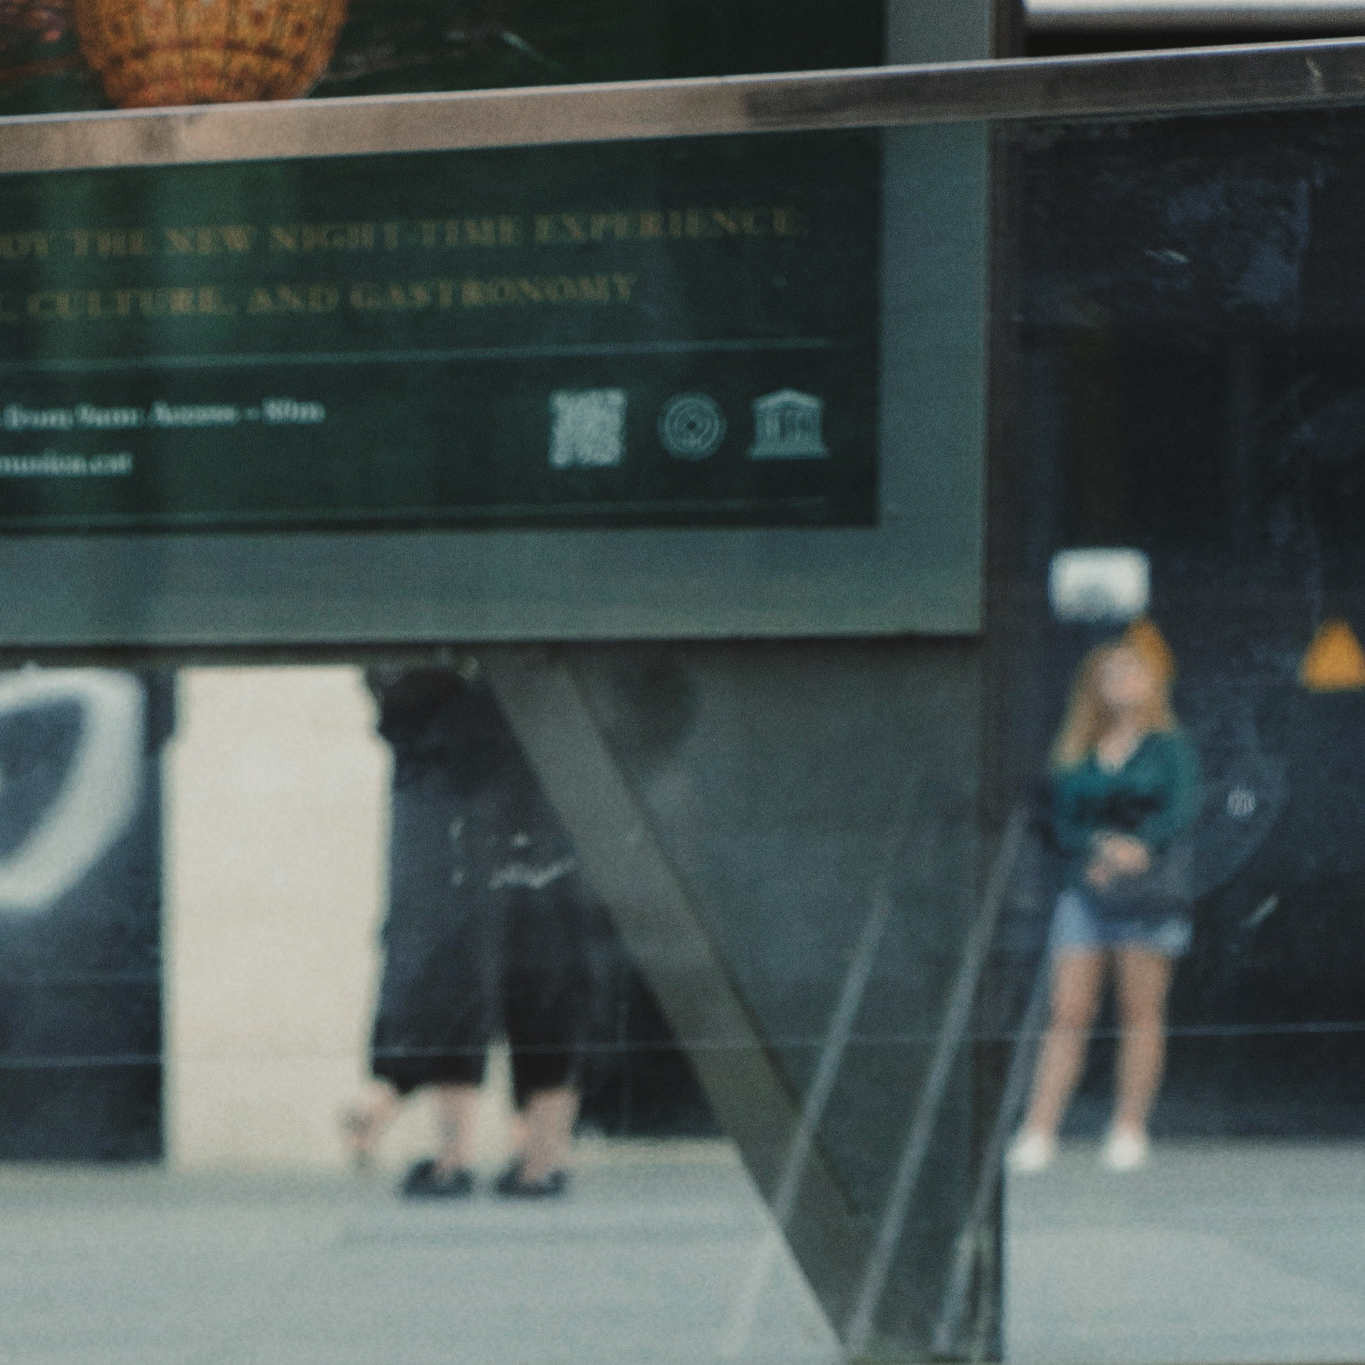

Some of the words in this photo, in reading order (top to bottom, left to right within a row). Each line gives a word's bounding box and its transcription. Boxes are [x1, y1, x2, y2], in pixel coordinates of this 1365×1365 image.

[71, 228, 152, 258] THE
[165, 224, 257, 256] NEW
[247, 282, 339, 315] AND
[349, 273, 638, 310] GASTRONOMY
